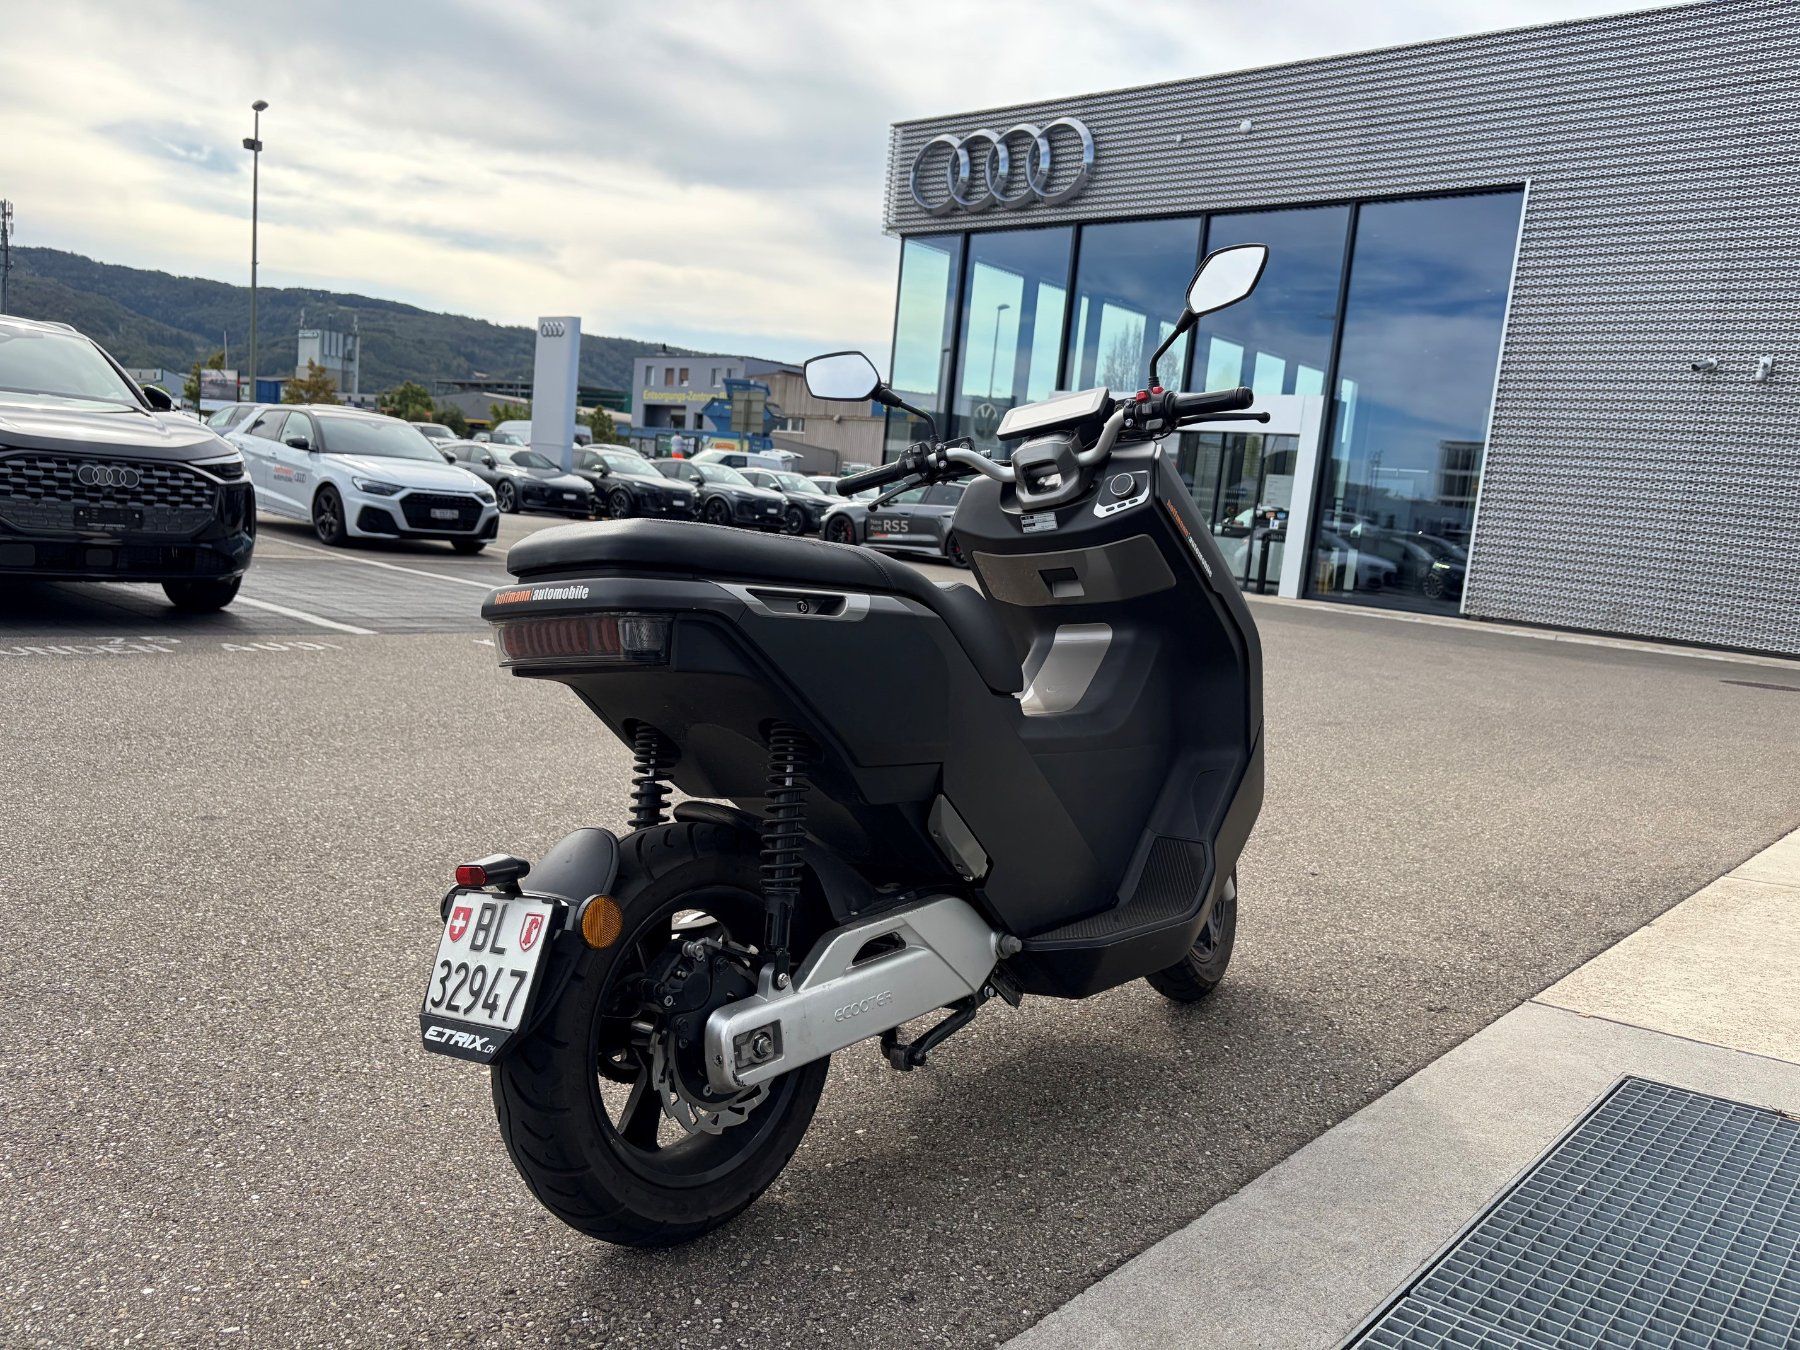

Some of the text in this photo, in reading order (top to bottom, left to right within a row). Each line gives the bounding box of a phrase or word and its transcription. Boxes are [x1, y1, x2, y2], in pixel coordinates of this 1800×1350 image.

[883, 519, 909, 533] RS5
[469, 902, 510, 955] BL
[430, 959, 529, 1023] 32947
